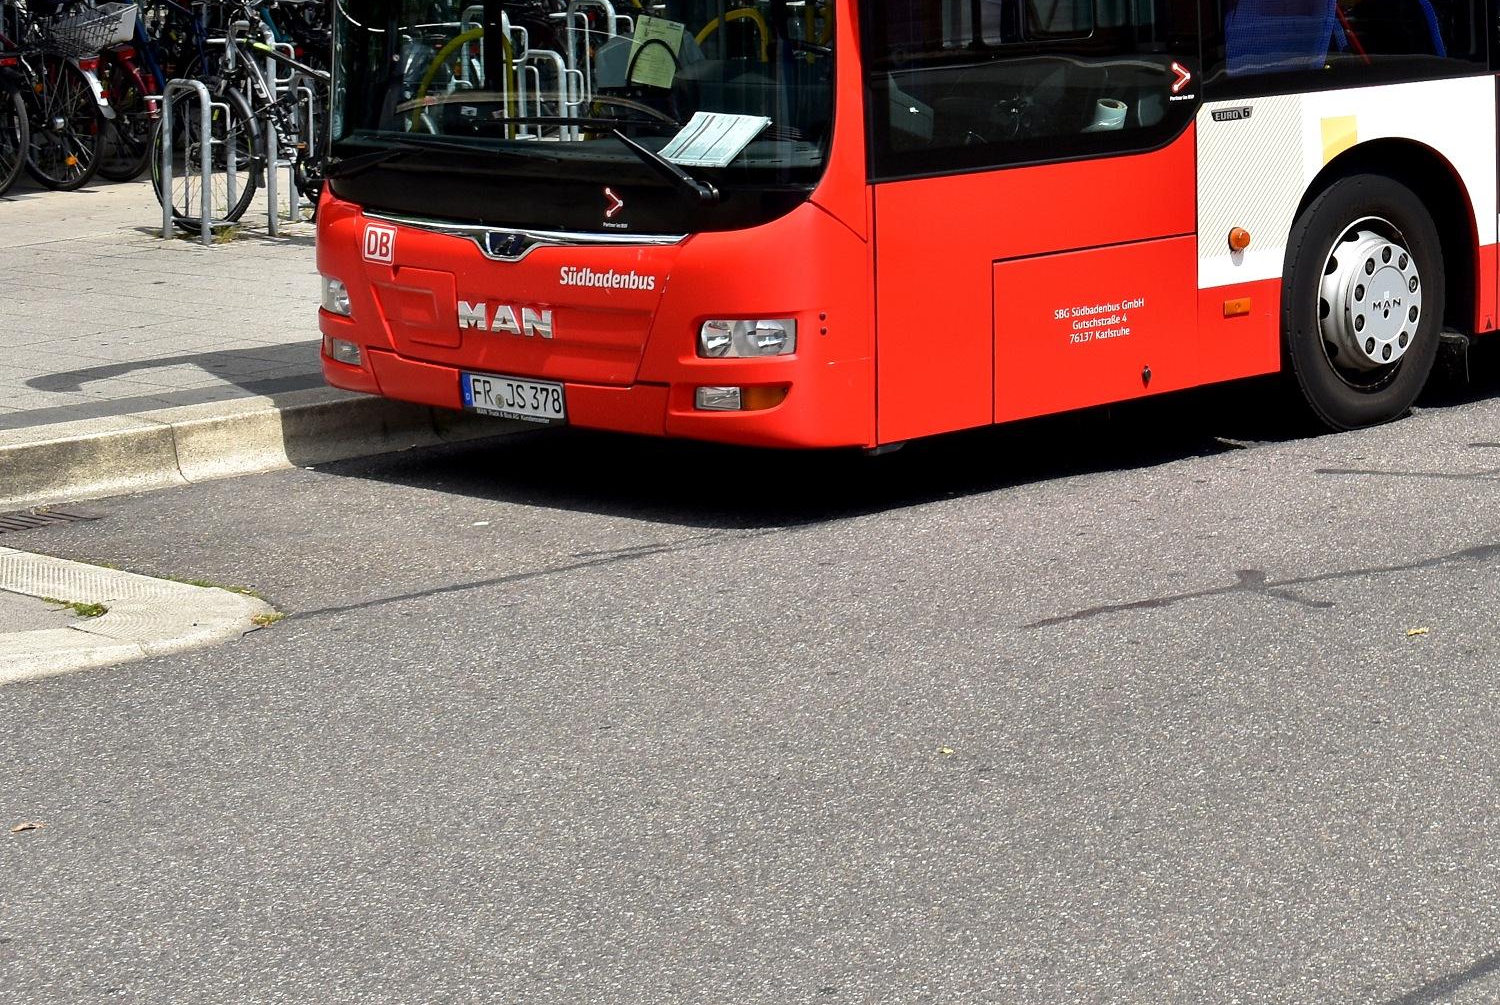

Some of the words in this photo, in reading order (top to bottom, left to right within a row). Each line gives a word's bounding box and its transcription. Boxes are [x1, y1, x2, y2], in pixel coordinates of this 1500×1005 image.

[1215, 110, 1239, 121] EURO
[1243, 108, 1250, 117] 6
[366, 228, 392, 257] DB
[559, 265, 656, 292] Südbadenbus
[1054, 307, 1070, 320] SBG
[1071, 303, 1120, 317] Südbadenbus
[1121, 297, 1145, 310] GmbH
[1372, 297, 1401, 310] MAN
[457, 300, 553, 339] MAN
[1069, 331, 1093, 344] 76137
[1095, 326, 1130, 340] Karlsruhe
[472, 378, 494, 405] FR
